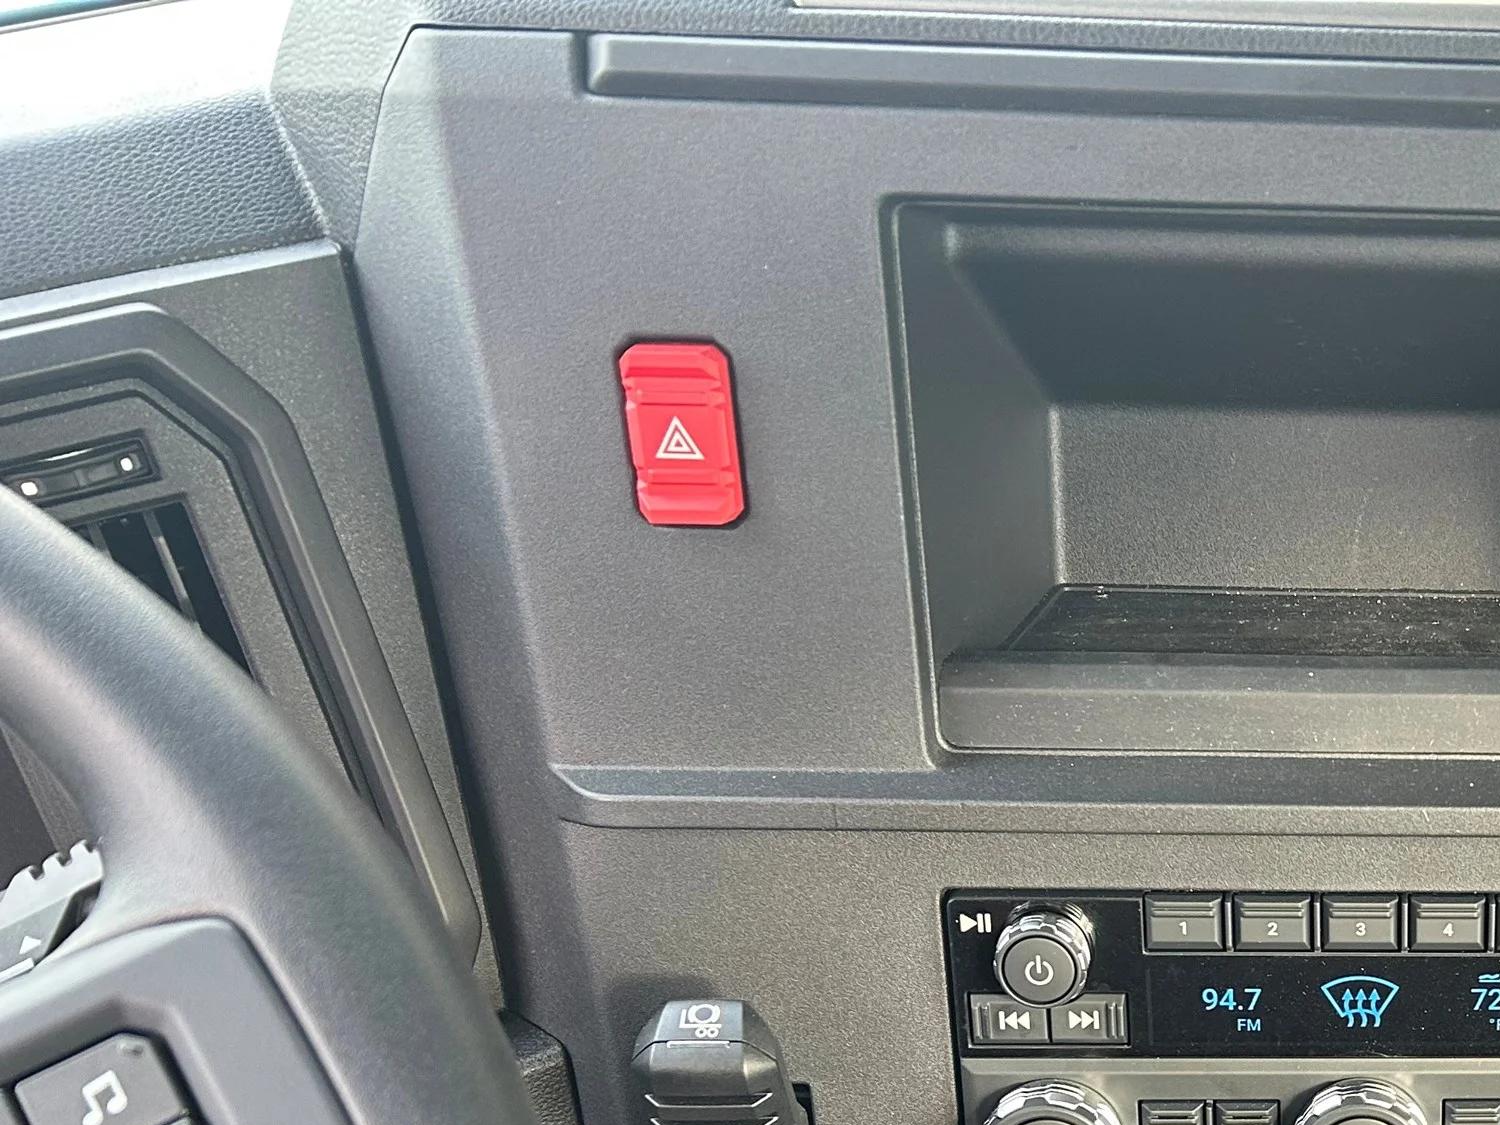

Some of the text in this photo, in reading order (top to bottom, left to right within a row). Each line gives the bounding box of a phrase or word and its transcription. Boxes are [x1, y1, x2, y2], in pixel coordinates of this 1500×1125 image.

[1179, 921, 1188, 936] 1
[1267, 922, 1279, 936] 2
[1355, 922, 1367, 936] 3
[1442, 923, 1454, 937] 4
[1202, 988, 1262, 1010] 94.7
[1237, 1018, 1261, 1031] FM
